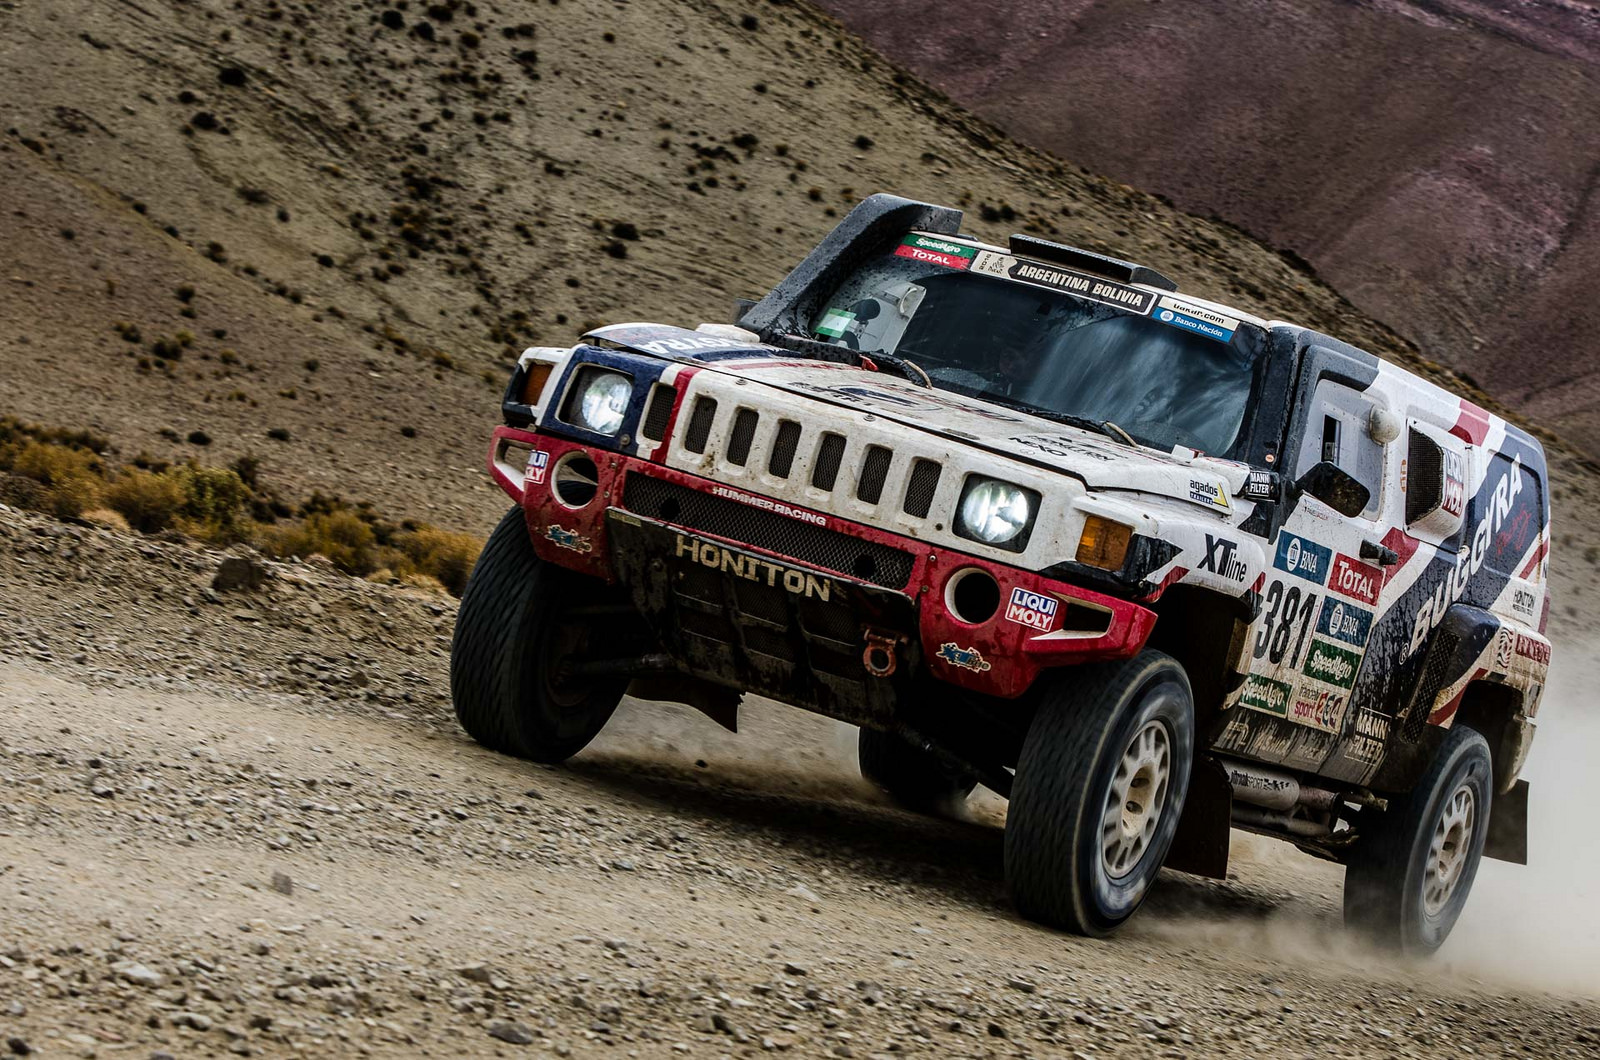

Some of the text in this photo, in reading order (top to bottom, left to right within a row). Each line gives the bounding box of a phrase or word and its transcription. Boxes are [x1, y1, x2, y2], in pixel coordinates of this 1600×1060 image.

[912, 248, 951, 265] TOTAL
[916, 237, 961, 253] SpeedAgro
[1017, 265, 1144, 306] ARGENTINA BOLIVIA
[1174, 316, 1224, 338] Banco Nación
[1189, 479, 1219, 497] agados
[1249, 483, 1270, 495] FILTER
[1250, 471, 1271, 484] MANN
[1197, 533, 1248, 583] XTline
[1299, 550, 1318, 573] BNA
[1408, 452, 1524, 658] BUGGYRA
[675, 533, 831, 602] HONITON
[1338, 560, 1374, 600] TOTAL
[1013, 590, 1056, 615] LIQUI
[1008, 605, 1052, 629] MOLY
[1253, 579, 1318, 670] 381
[1341, 616, 1360, 637] BNA
[1311, 649, 1353, 681] SpeedAgro
[1294, 700, 1317, 719] sport
[1356, 712, 1390, 741] MANN
[1350, 734, 1384, 762] FILTER
